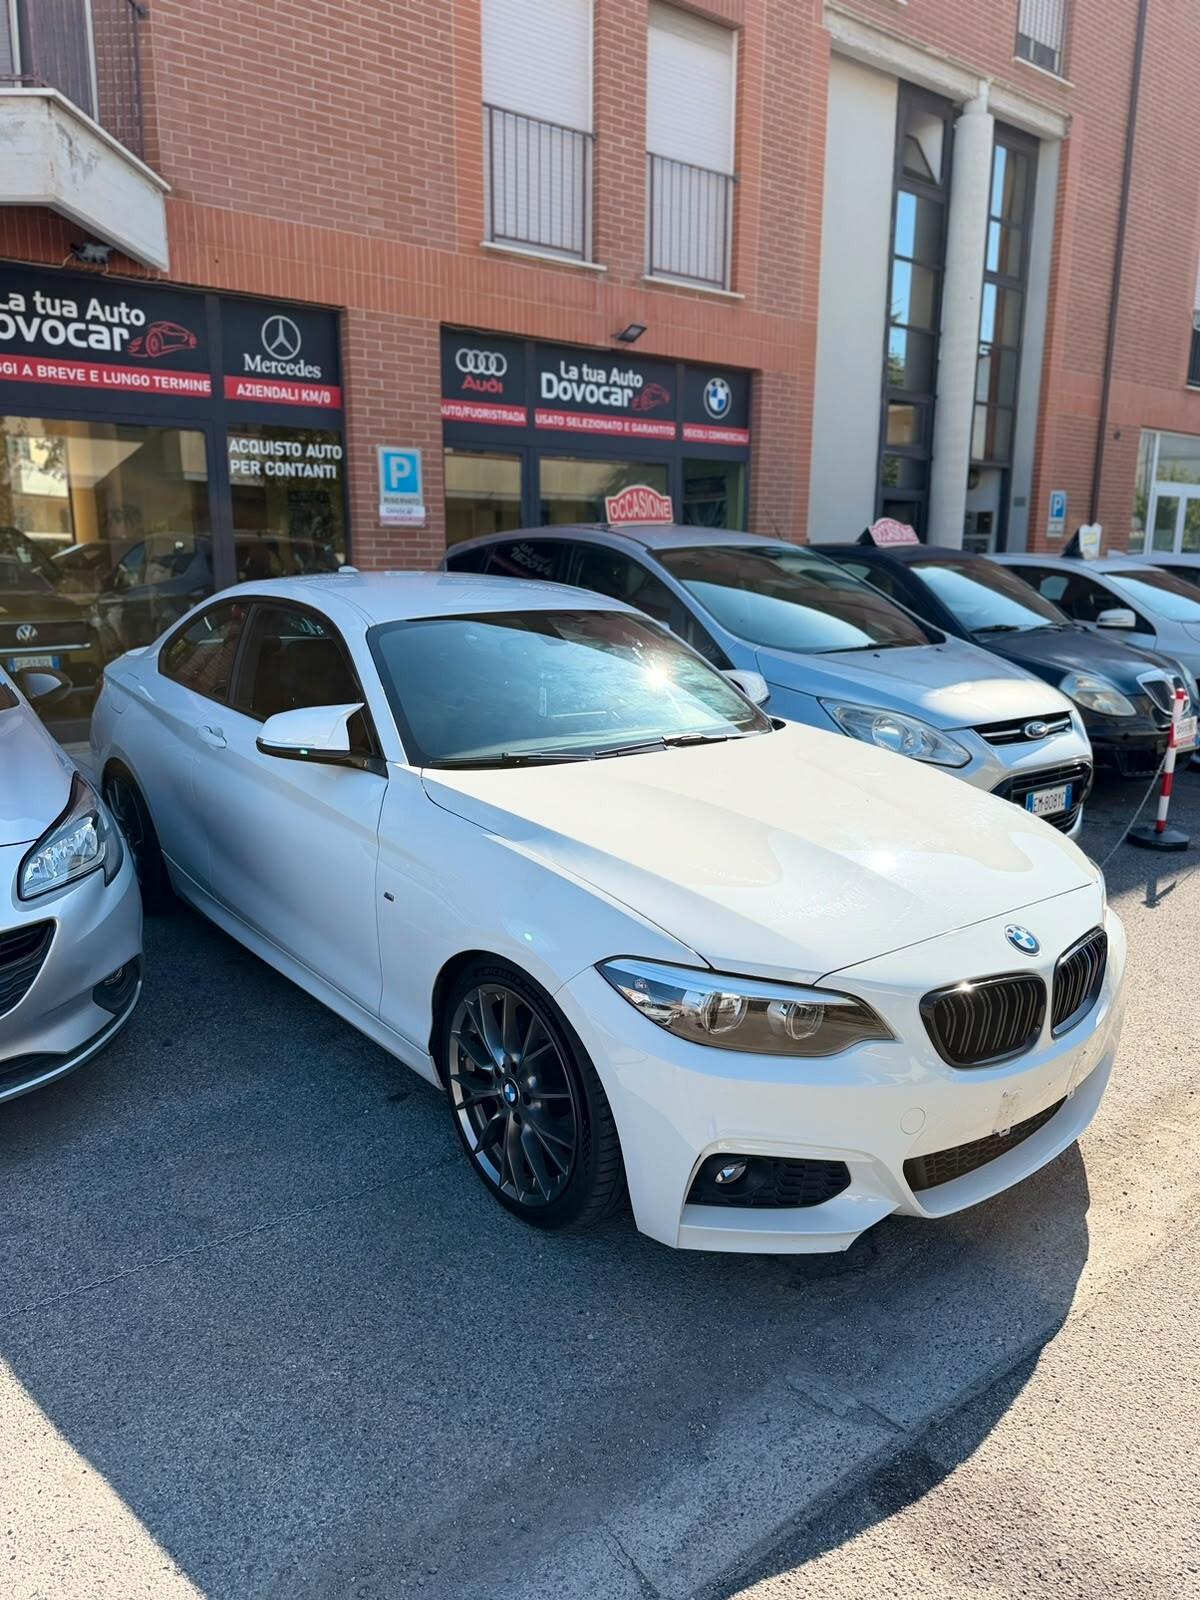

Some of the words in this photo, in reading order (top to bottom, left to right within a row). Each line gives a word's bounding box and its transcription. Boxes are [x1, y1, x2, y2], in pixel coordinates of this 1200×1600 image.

[32, 290, 78, 318] tua
[86, 297, 146, 327] Auto
[22, 363, 33, 376] A
[36, 364, 86, 381] BREVE
[89, 369, 100, 382] E
[103, 372, 150, 387] LUNGO
[152, 375, 212, 392] TERMINE
[243, 353, 322, 379] Mercedes
[560, 360, 579, 380] La
[582, 363, 607, 384] tua
[609, 367, 644, 388] Auto
[236, 383, 299, 400] AZIENDALI
[462, 374, 504, 394] Audi
[541, 372, 634, 407] Dovocar
[535, 412, 565, 426] USATO
[566, 416, 624, 432] SELEZIONATO
[228, 438, 302, 457] ACQUISTO
[306, 443, 343, 460] AUTO
[230, 459, 261, 476] PER
[265, 462, 337, 480] CONTANTI
[390, 455, 411, 489] P
[610, 490, 671, 519] OCCASIONE
[1053, 496, 1063, 517] P
